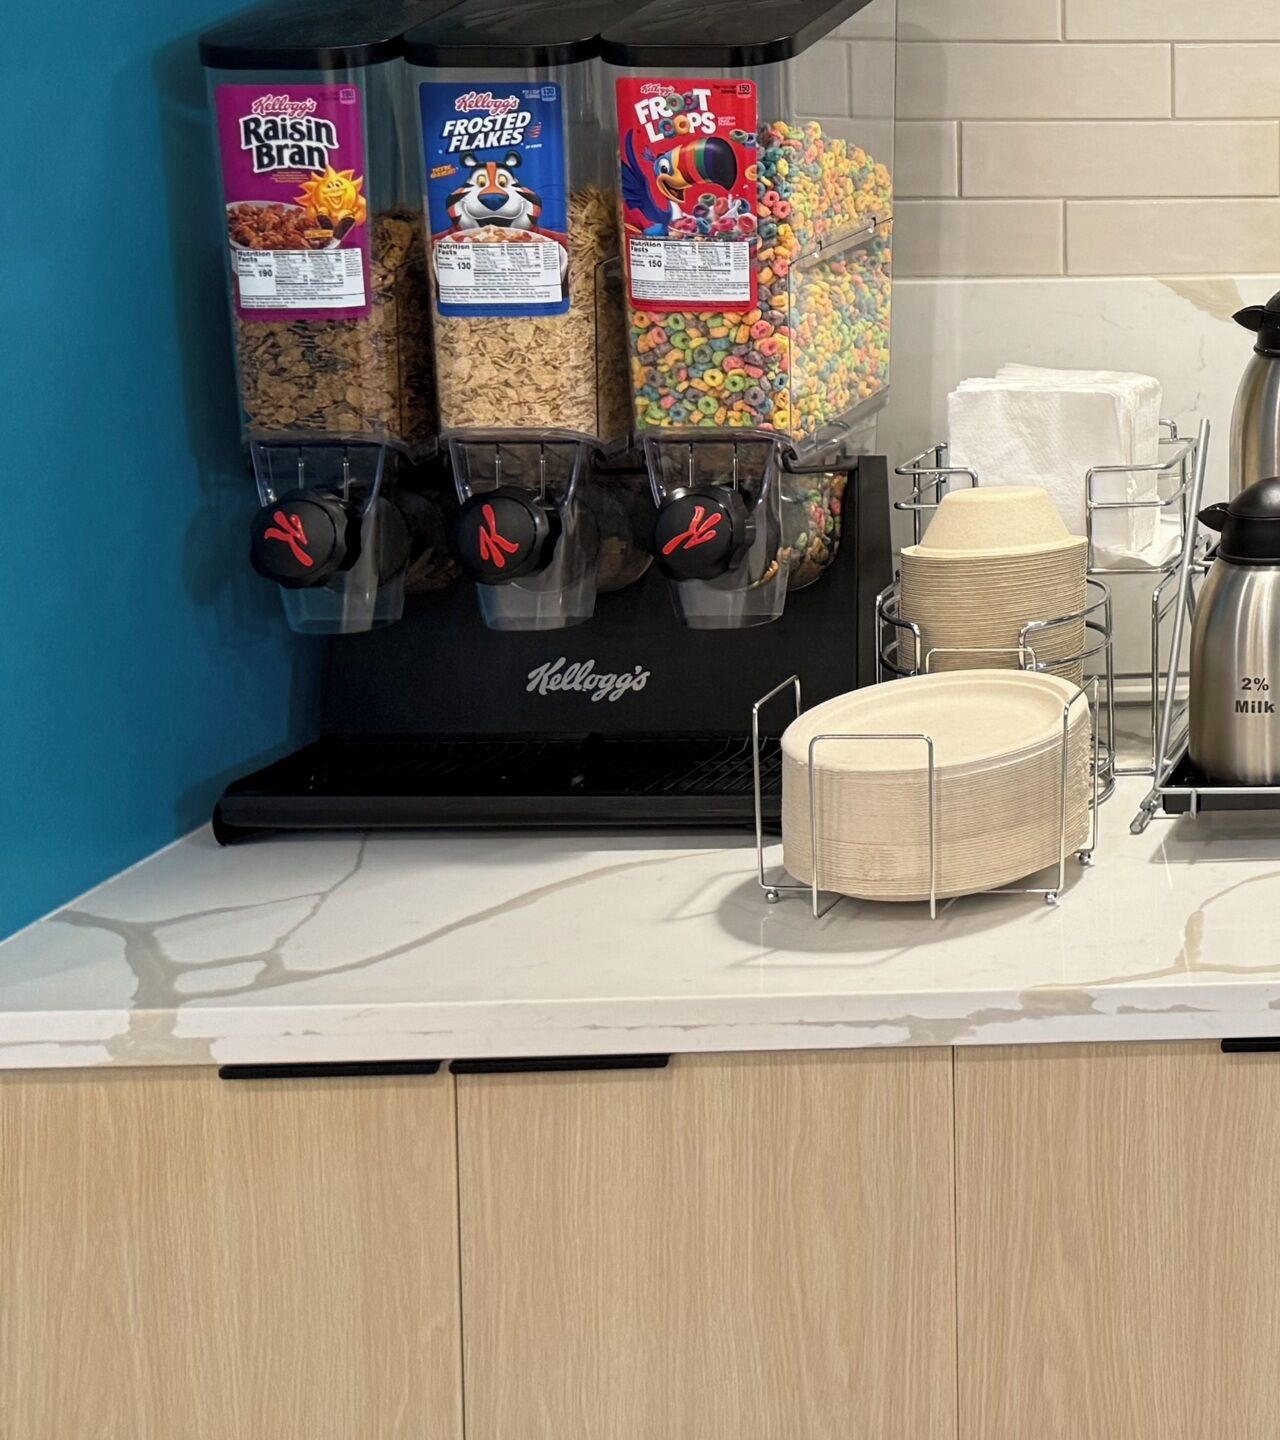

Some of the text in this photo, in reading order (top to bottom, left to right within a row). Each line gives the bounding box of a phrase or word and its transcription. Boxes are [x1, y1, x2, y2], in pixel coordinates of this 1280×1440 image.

[455, 91, 520, 113] Kellogg's
[640, 83, 675, 97] Kellogg's
[252, 94, 317, 118] Kellogg's
[634, 88, 711, 125] FROOT
[240, 116, 338, 148] Raisin
[442, 111, 531, 137] FROSTED
[644, 112, 717, 144] LOOPS
[448, 128, 524, 153] FLAKES
[254, 143, 329, 173] Bran
[258, 269, 273, 278] 190
[457, 262, 471, 270] 130
[648, 260, 662, 268] 150
[526, 656, 652, 703] Kellogg's
[1241, 677, 1269, 691] 2%
[1235, 700, 1275, 714] Milk
